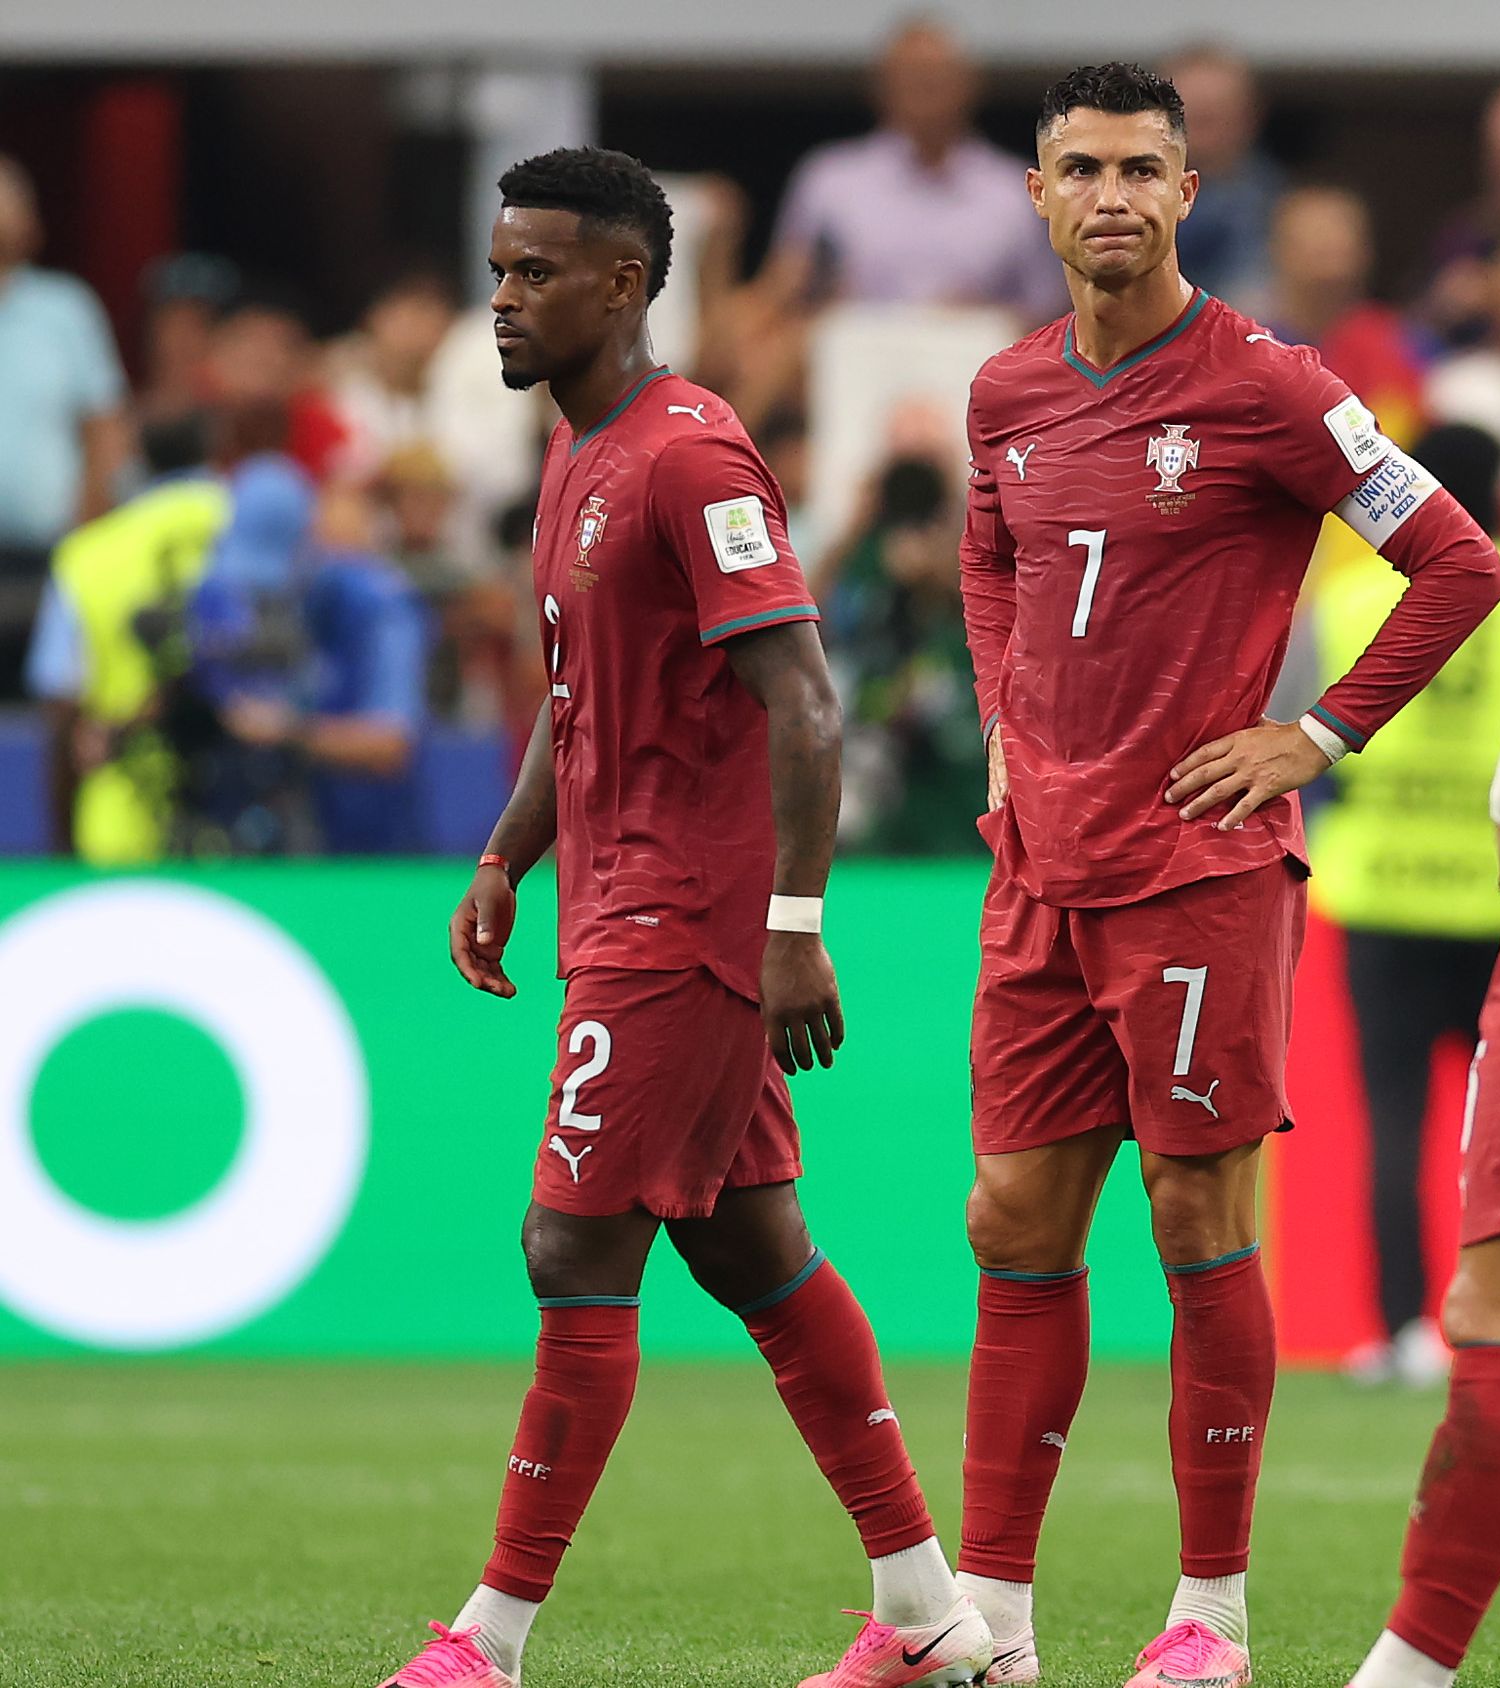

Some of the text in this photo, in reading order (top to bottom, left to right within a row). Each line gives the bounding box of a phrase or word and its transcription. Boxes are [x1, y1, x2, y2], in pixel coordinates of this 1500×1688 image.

[1355, 460, 1406, 509] UNITES
[1368, 469, 1418, 522] the World
[1392, 494, 1416, 519] FIFA
[1067, 528, 1107, 638] 7
[1162, 965, 1209, 1076] 7
[558, 1020, 612, 1132] 2
